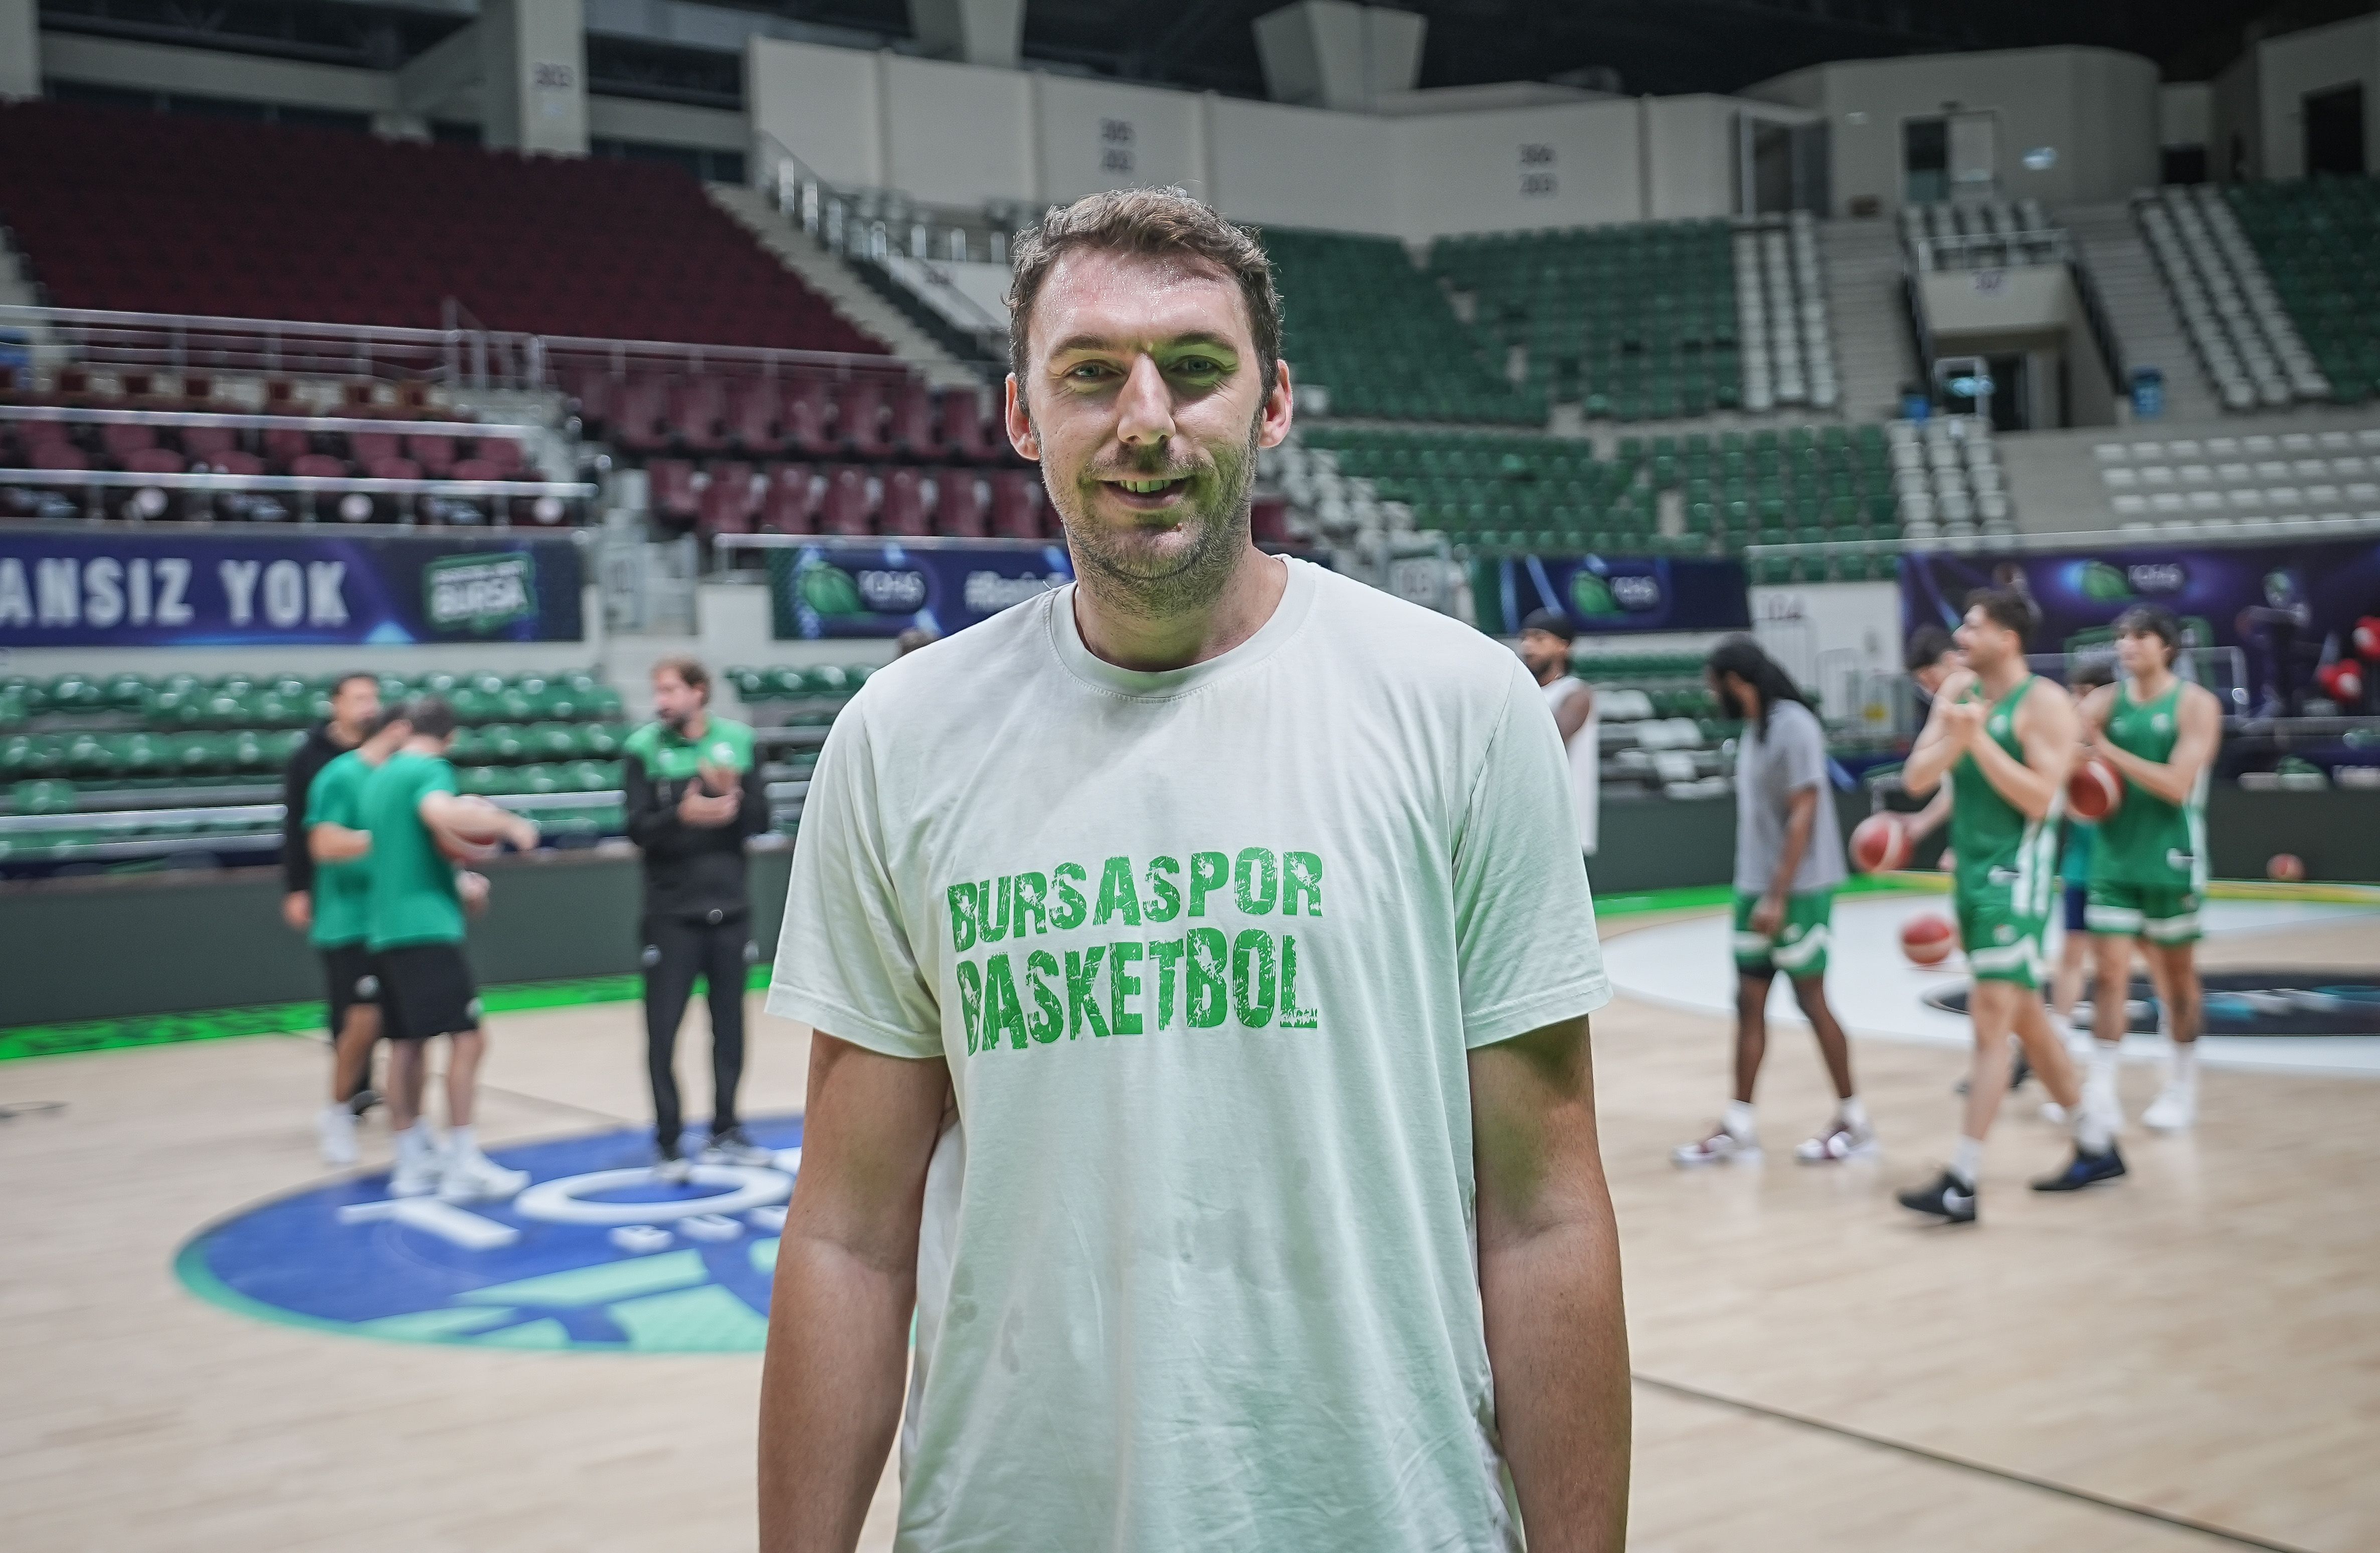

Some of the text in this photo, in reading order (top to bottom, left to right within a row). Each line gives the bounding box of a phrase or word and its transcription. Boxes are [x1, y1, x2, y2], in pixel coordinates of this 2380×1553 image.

[0, 556, 349, 627] ANSIZ YOK
[947, 847, 1323, 952] BURSASPOR
[957, 927, 1318, 1057] BASKETBOL
